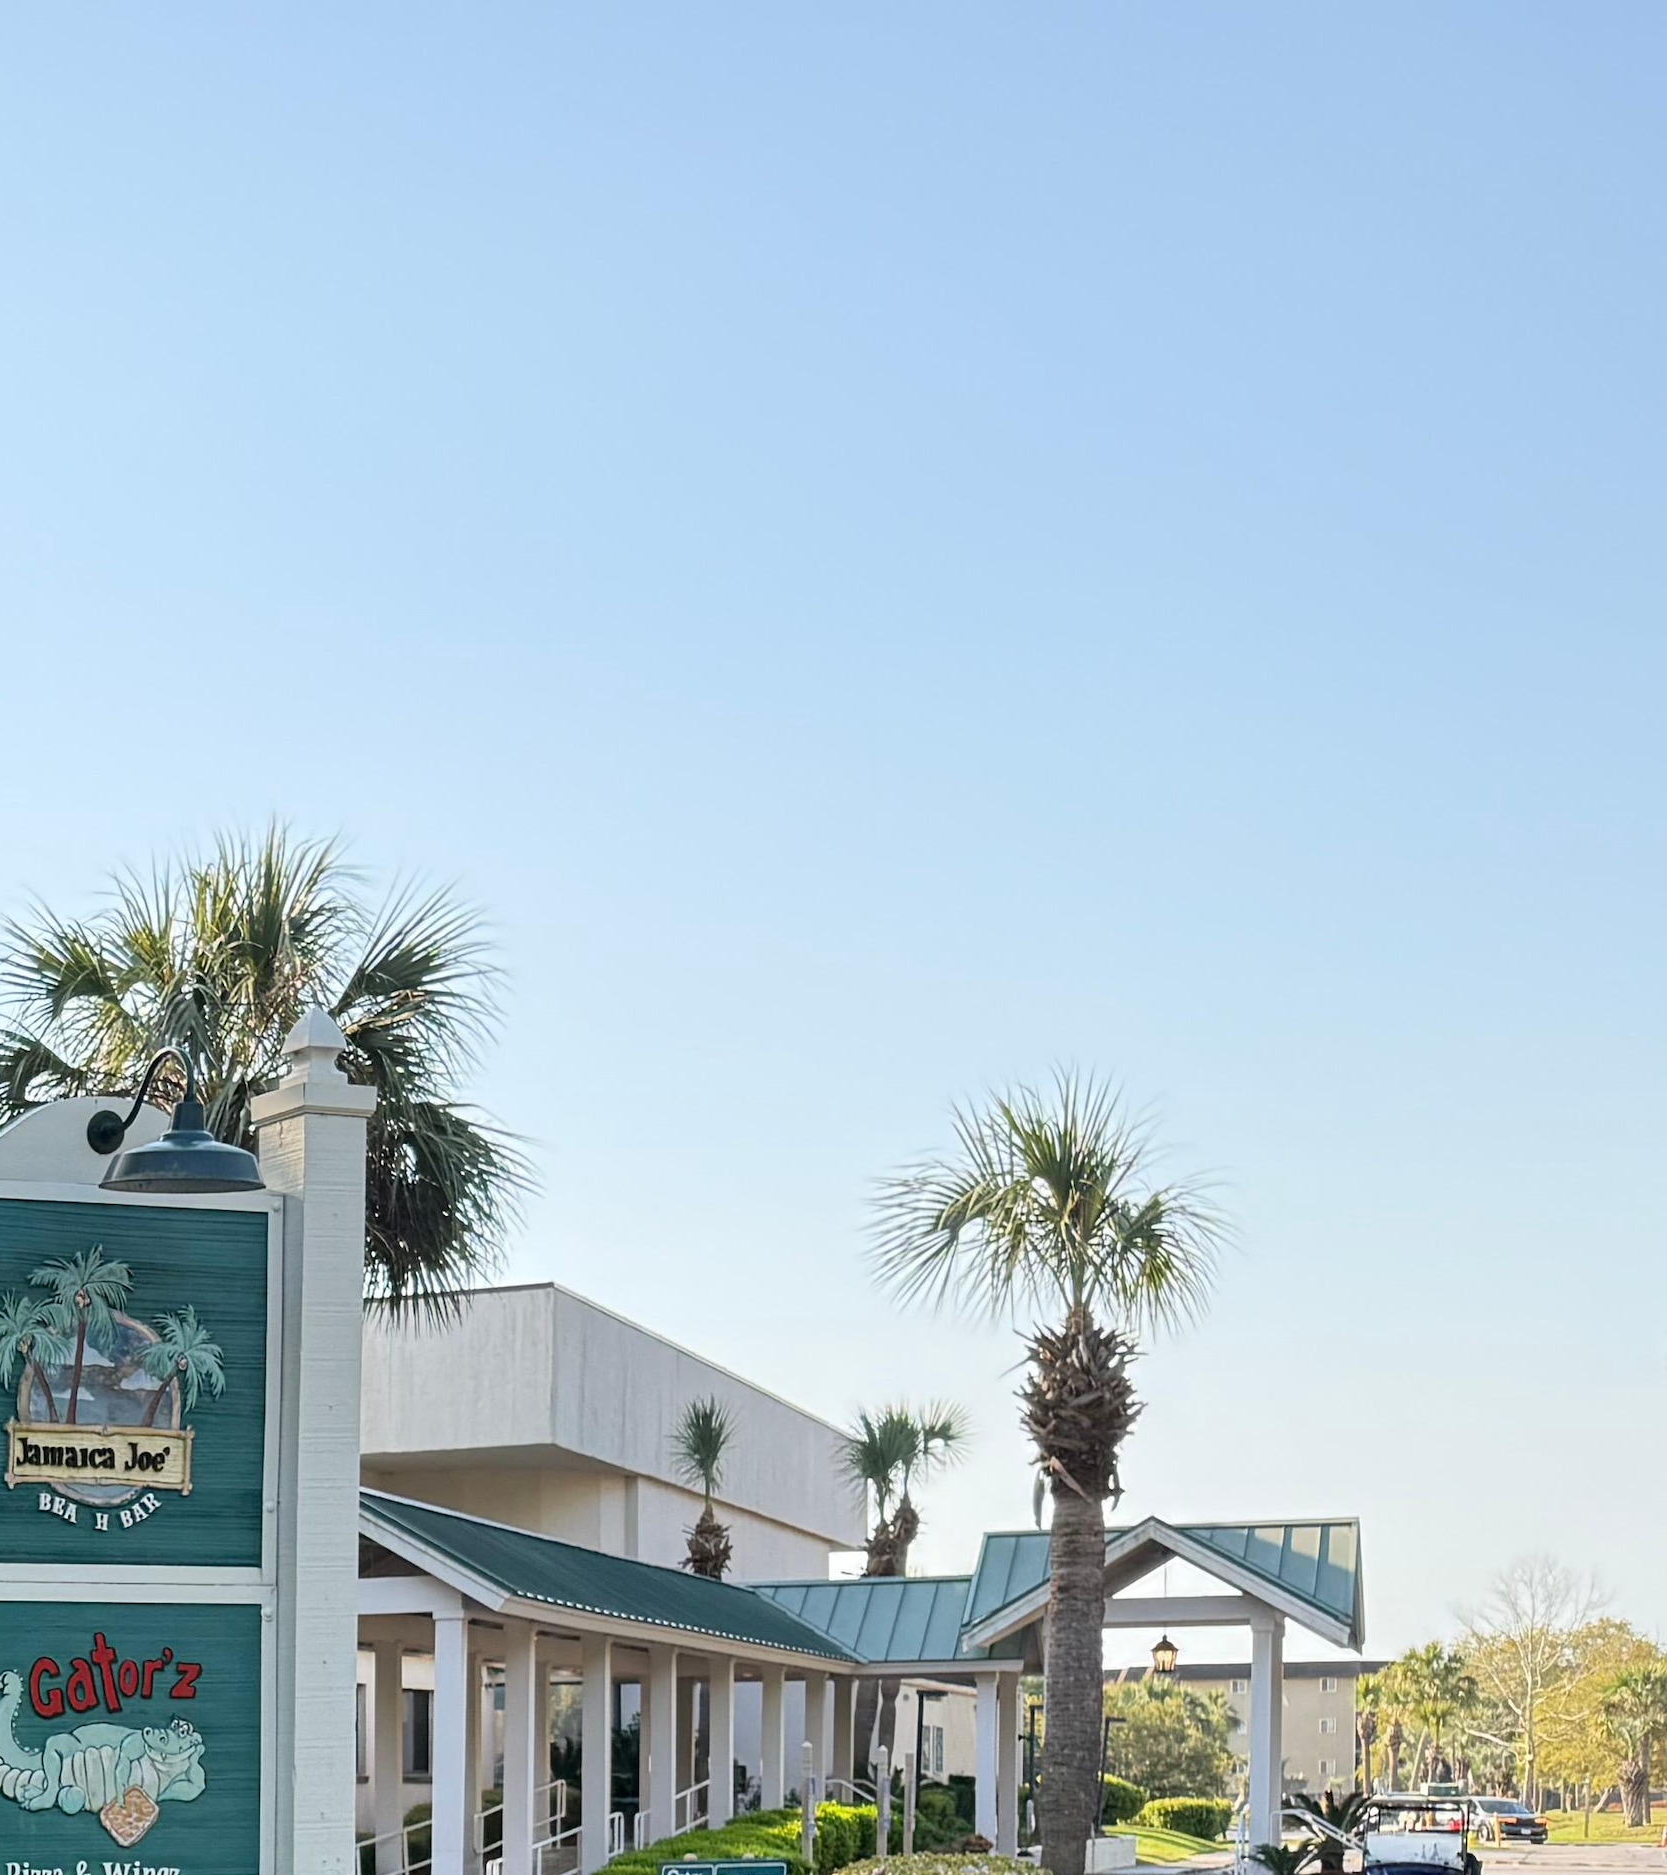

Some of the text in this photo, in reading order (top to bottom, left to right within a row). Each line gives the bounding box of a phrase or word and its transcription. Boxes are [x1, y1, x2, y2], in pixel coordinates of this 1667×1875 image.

[16, 1437, 115, 1470] Jamaica
[119, 1493, 162, 1528] BAR
[29, 1632, 202, 1718] Gator'z
